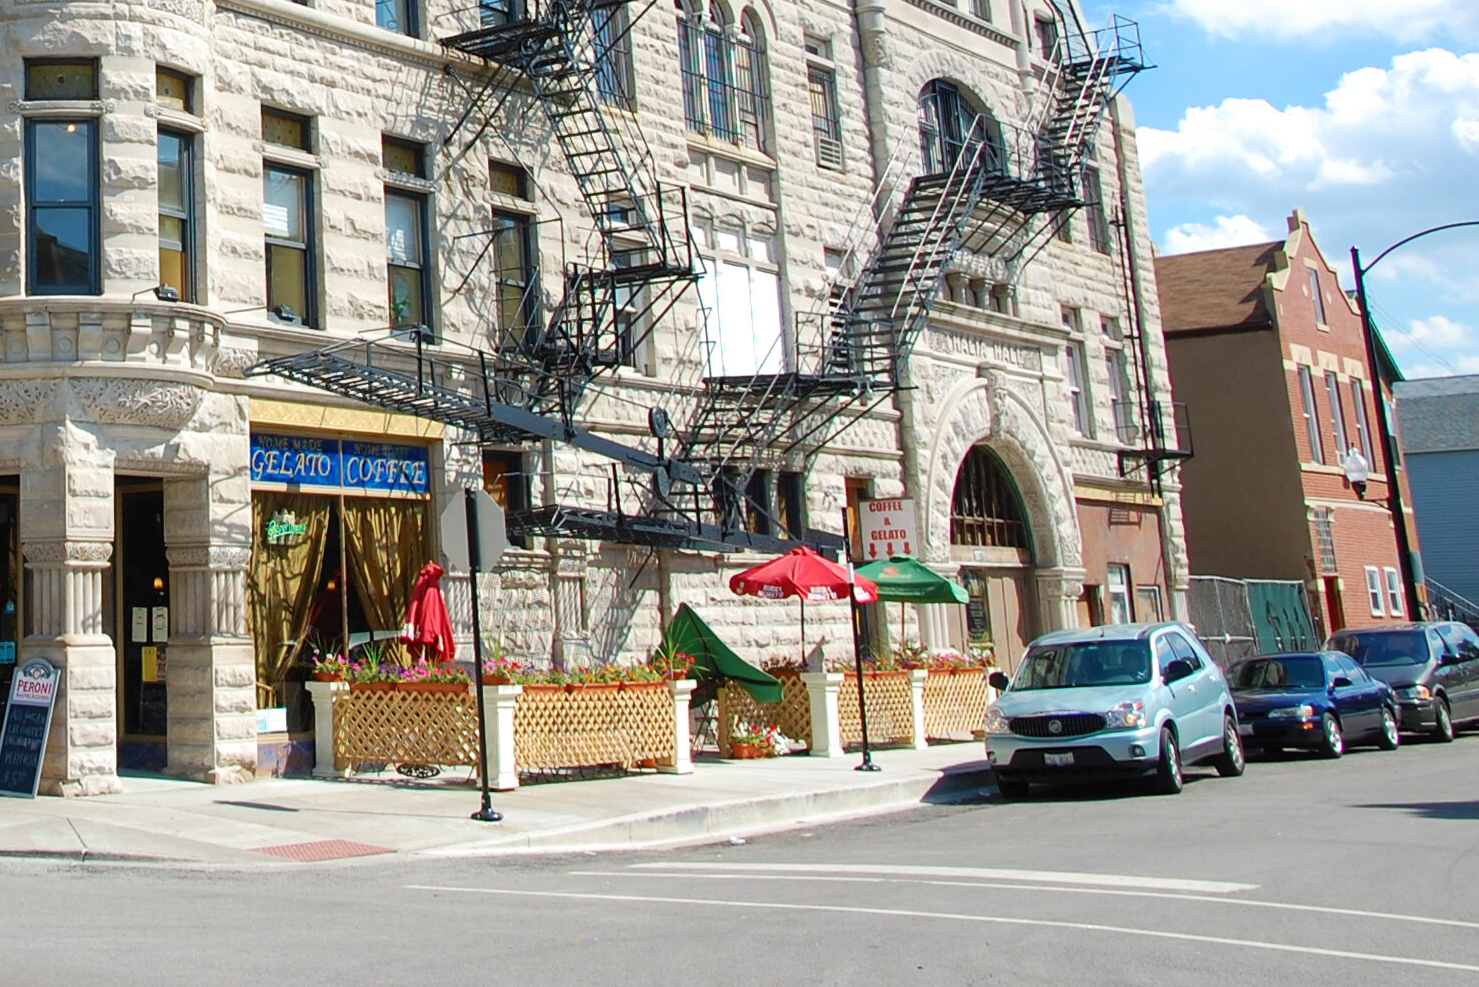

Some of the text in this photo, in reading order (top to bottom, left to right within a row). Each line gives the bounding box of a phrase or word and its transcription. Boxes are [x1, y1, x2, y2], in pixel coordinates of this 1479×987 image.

[993, 344, 1025, 366] HALL
[252, 449, 331, 481] GELATO
[347, 457, 426, 484] COFFEE
[868, 500, 903, 514] COFFEE
[884, 517, 892, 526] &
[871, 529, 907, 541] GELATO
[17, 679, 53, 694] PERONI
